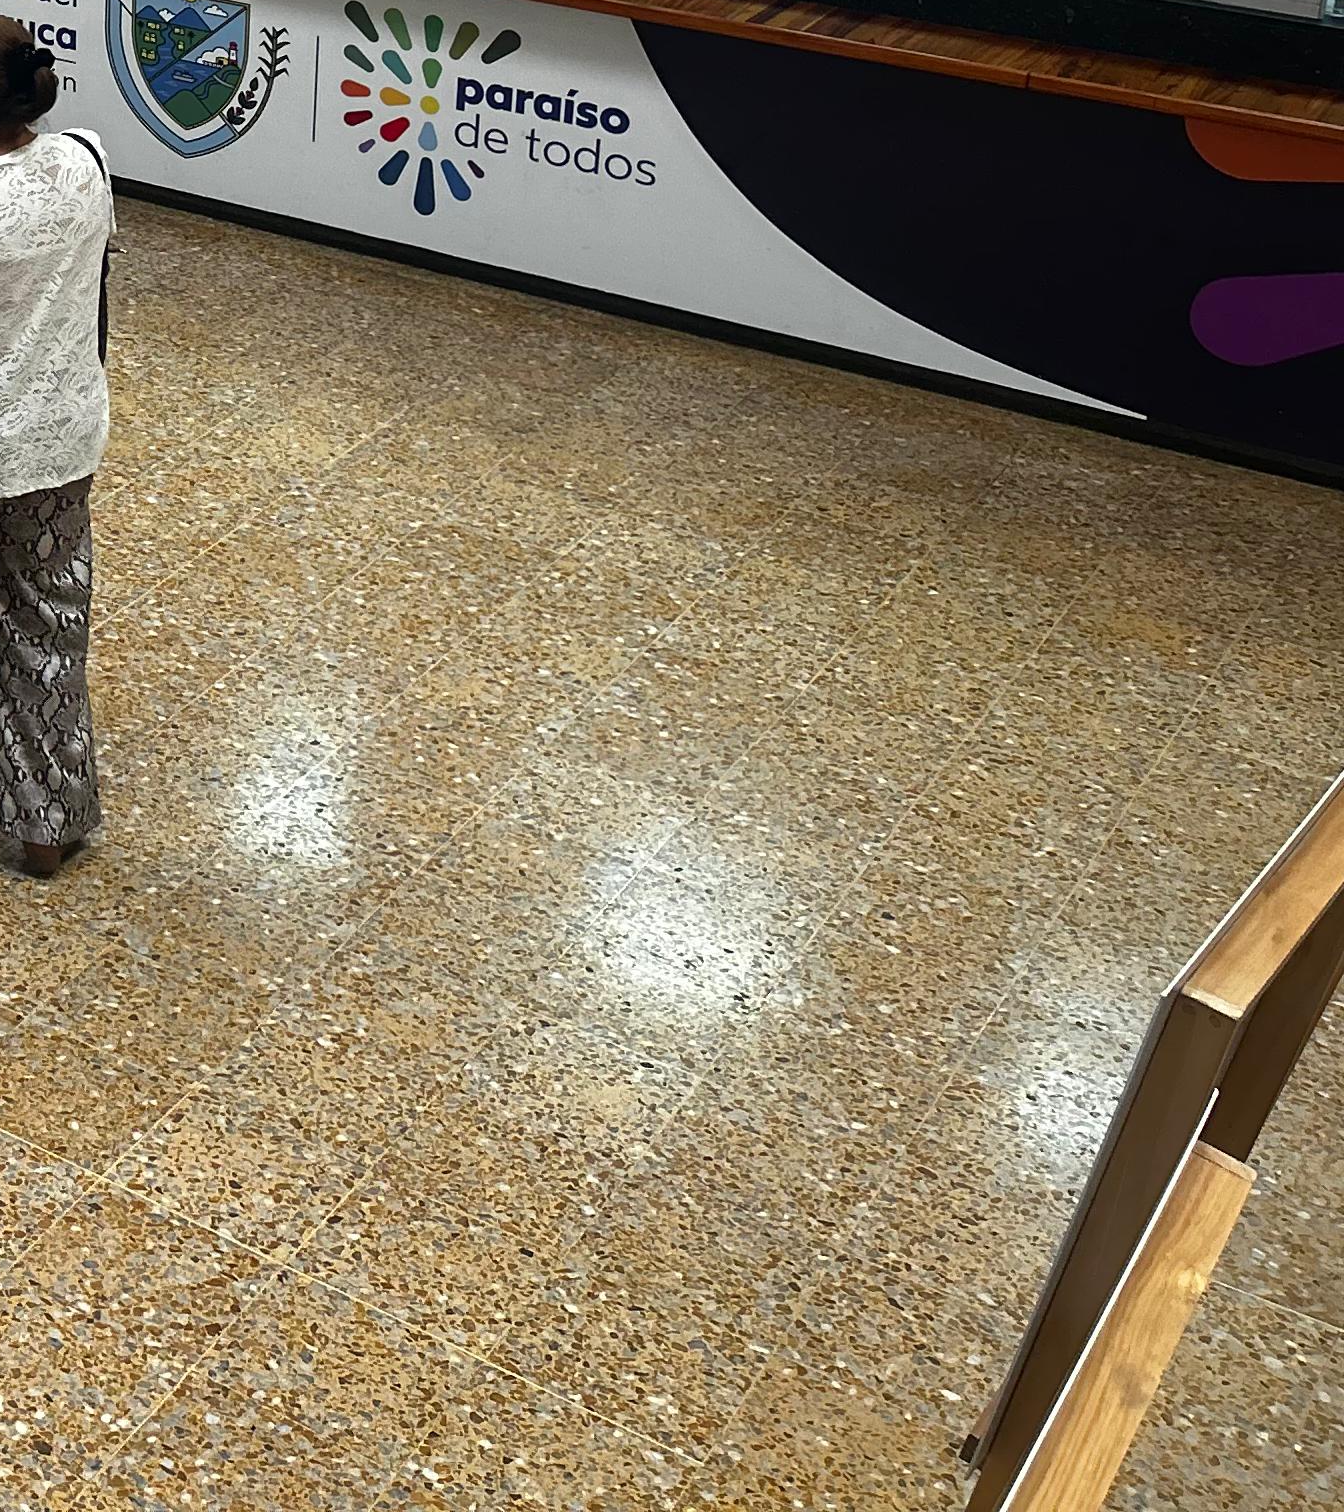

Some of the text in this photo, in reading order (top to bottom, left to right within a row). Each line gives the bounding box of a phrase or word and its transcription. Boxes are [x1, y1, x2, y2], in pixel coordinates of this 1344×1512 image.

[455, 77, 631, 135] paraíso
[454, 113, 657, 186] de todos
